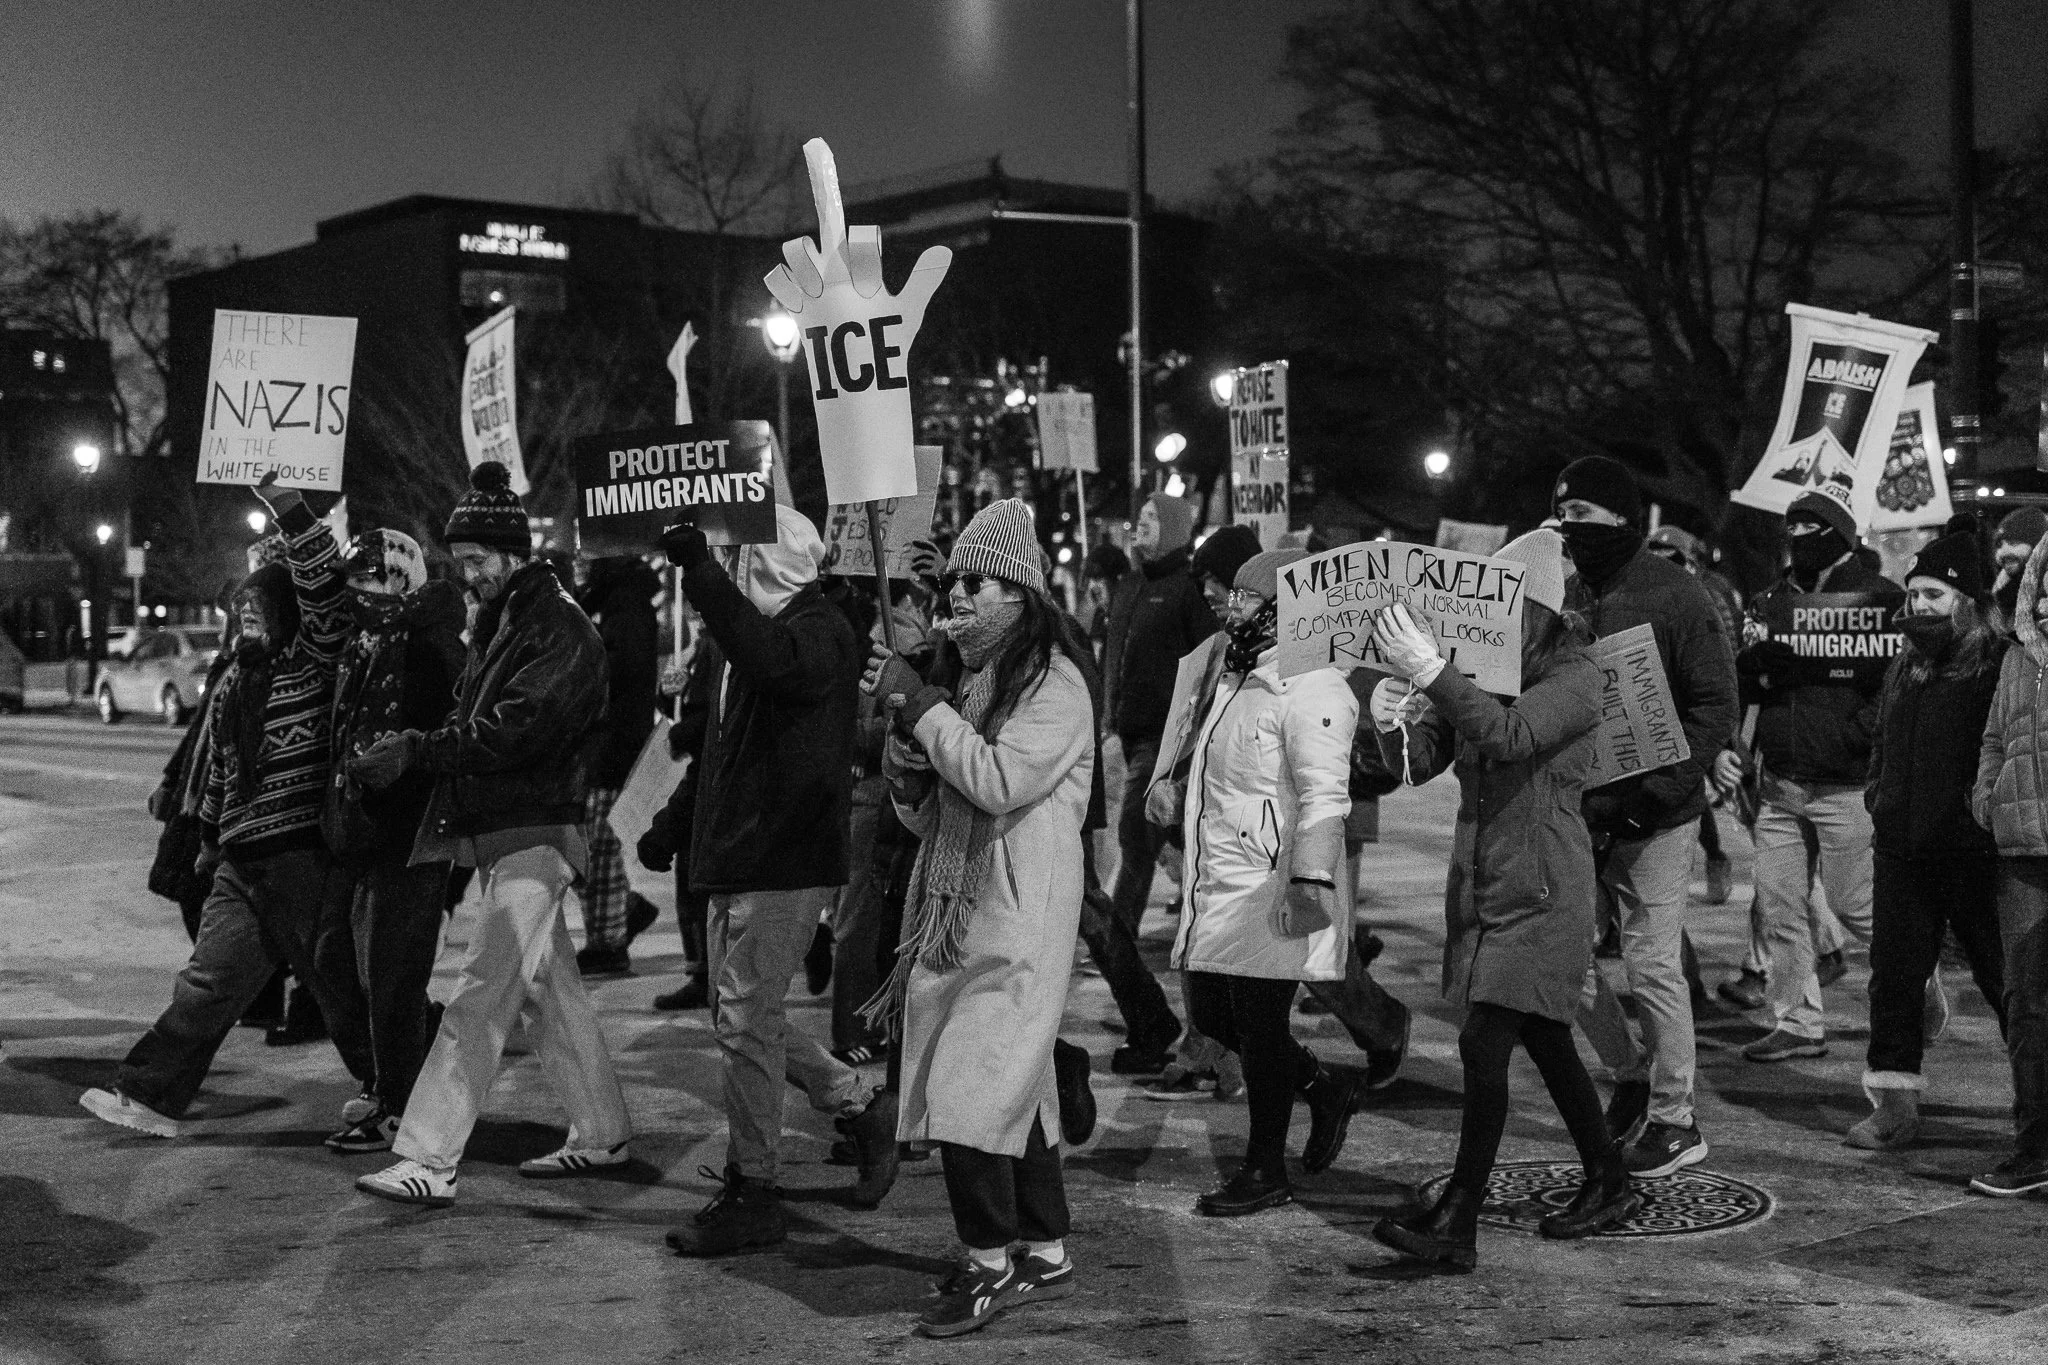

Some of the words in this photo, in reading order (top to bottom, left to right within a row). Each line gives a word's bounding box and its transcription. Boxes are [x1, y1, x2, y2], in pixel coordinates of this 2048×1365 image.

[220, 313, 311, 347] THERE
[218, 348, 261, 371] ARE
[804, 314, 908, 400] ICE
[1807, 357, 1883, 389] ABOLISH
[210, 380, 348, 435] NAZIS
[208, 437, 228, 457] IN
[239, 437, 279, 457] THE
[609, 439, 730, 480] PROTECT
[206, 460, 263, 480] WHITE
[270, 463, 330, 482] HOUSE
[585, 472, 767, 517] IMMIGRANTS
[1283, 549, 1390, 599] WHEN
[1405, 547, 1526, 616] CRUELTY
[1326, 581, 1416, 607] BECOMES
[1423, 593, 1495, 621] NORMAL
[1441, 620, 1506, 647] LOOKS
[1793, 606, 1887, 631] PROTECT
[1624, 649, 1680, 763] IMMIGRANTS
[1612, 725, 1642, 771] THIS
